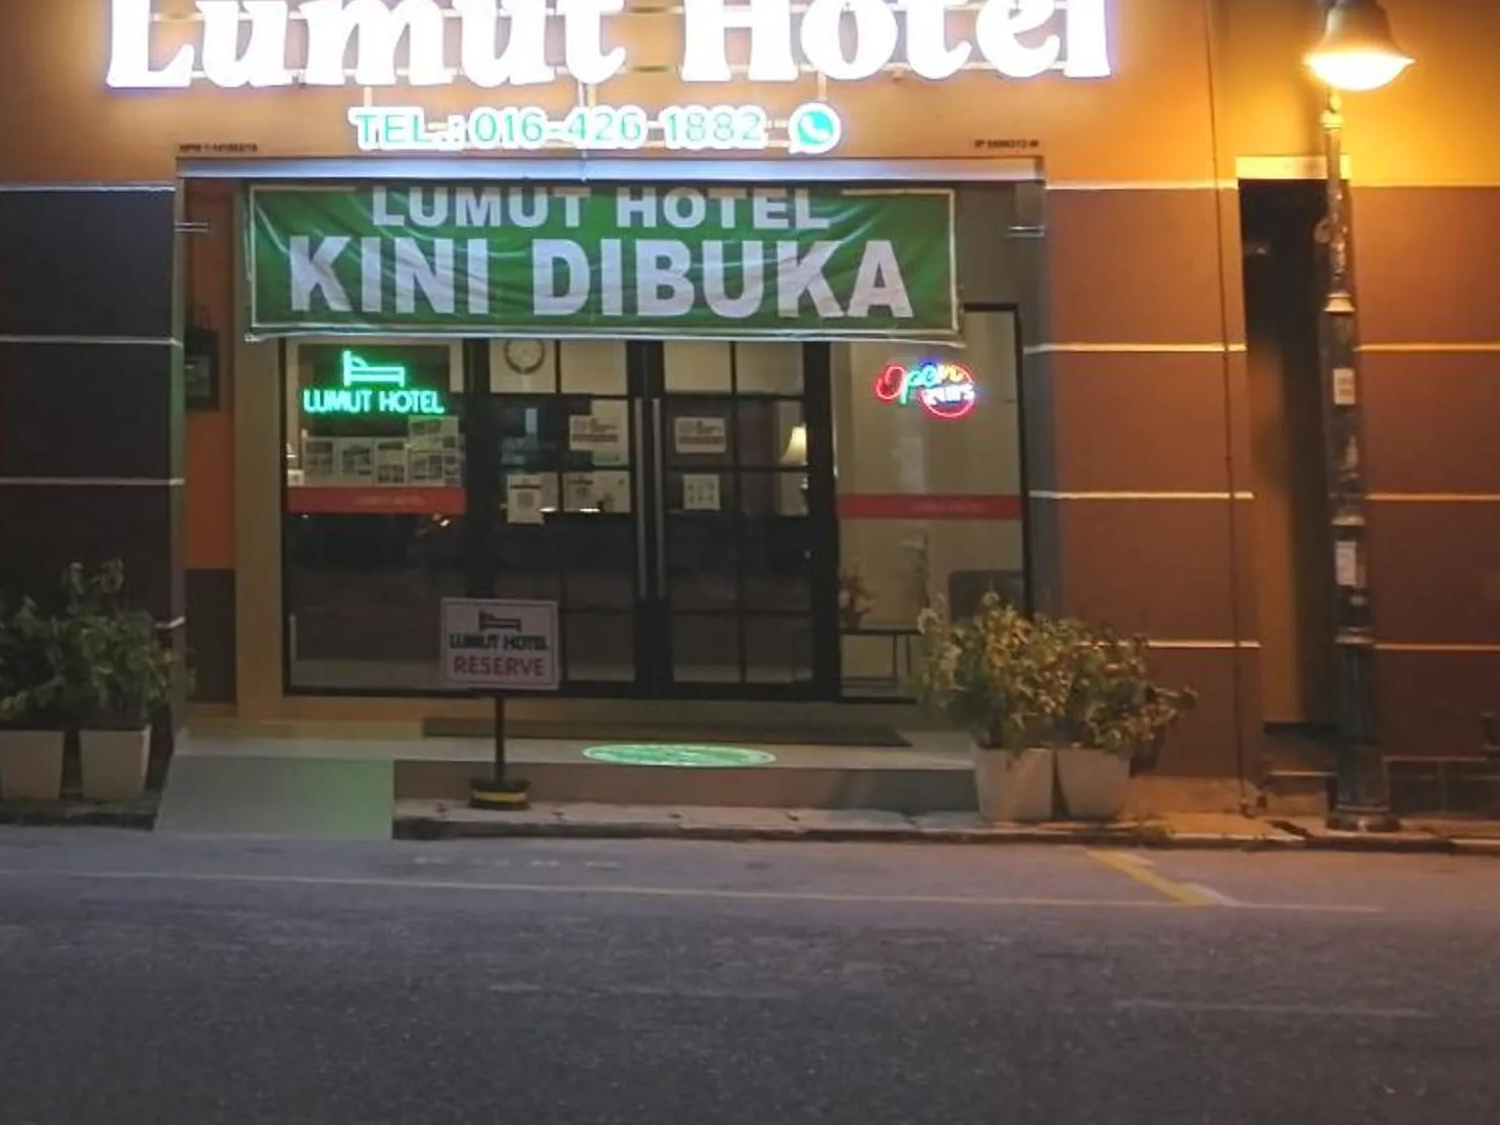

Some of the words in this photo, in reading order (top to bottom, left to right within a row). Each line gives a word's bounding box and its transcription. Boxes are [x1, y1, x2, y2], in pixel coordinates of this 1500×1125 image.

[663, 109, 765, 146] 1882
[372, 186, 590, 228] LUMUT
[617, 187, 831, 229] HOTEL
[289, 235, 489, 315] KINI
[532, 239, 914, 319] DIBUKA
[303, 388, 373, 413] LUMUT
[379, 389, 446, 414] HOTEL
[450, 633, 500, 650] LUMUT
[503, 634, 549, 652] HOTEL
[453, 655, 546, 677] RESERVE
